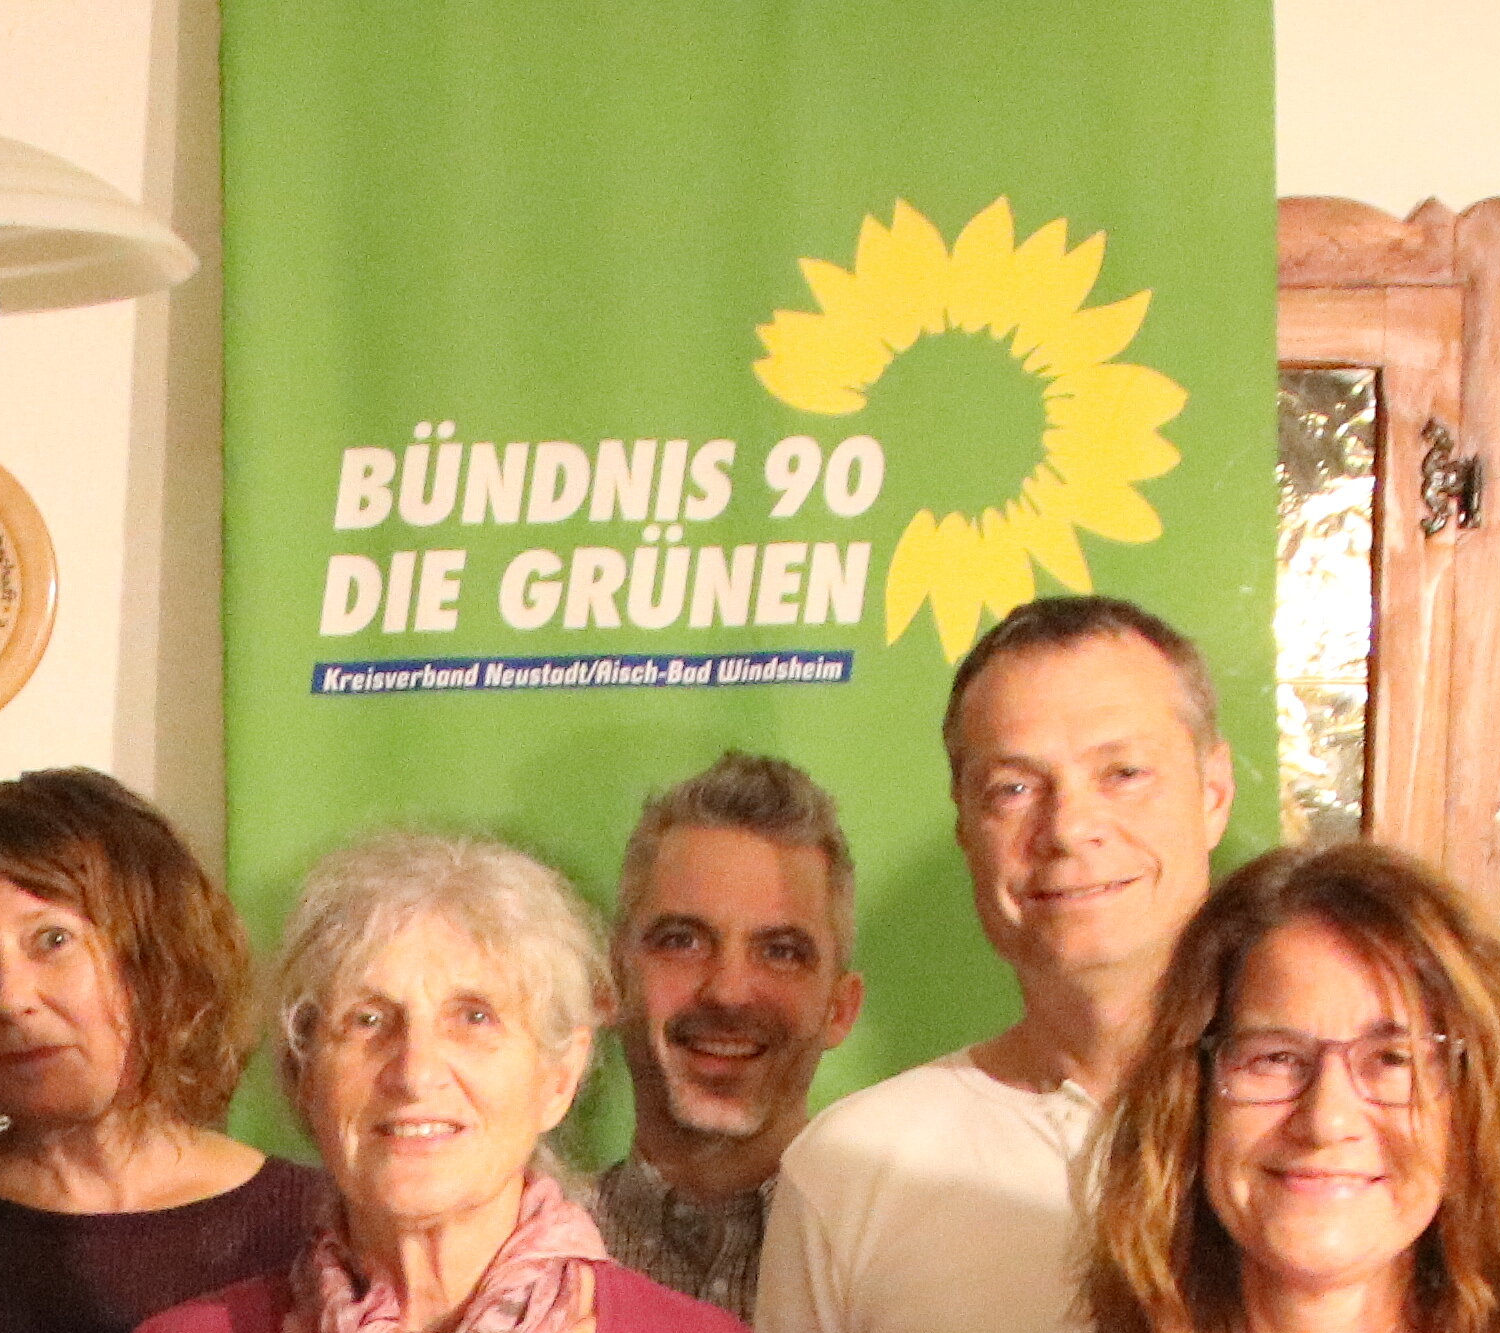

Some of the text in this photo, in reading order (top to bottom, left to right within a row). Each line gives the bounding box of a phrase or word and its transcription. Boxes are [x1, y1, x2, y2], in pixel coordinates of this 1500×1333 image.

[334, 420, 886, 530] BÜNDNIS 90
[319, 524, 872, 636] DIE GRÜNEN
[323, 656, 845, 692] Kreisverband Neustadt/Aisch-Bad Windsheim
